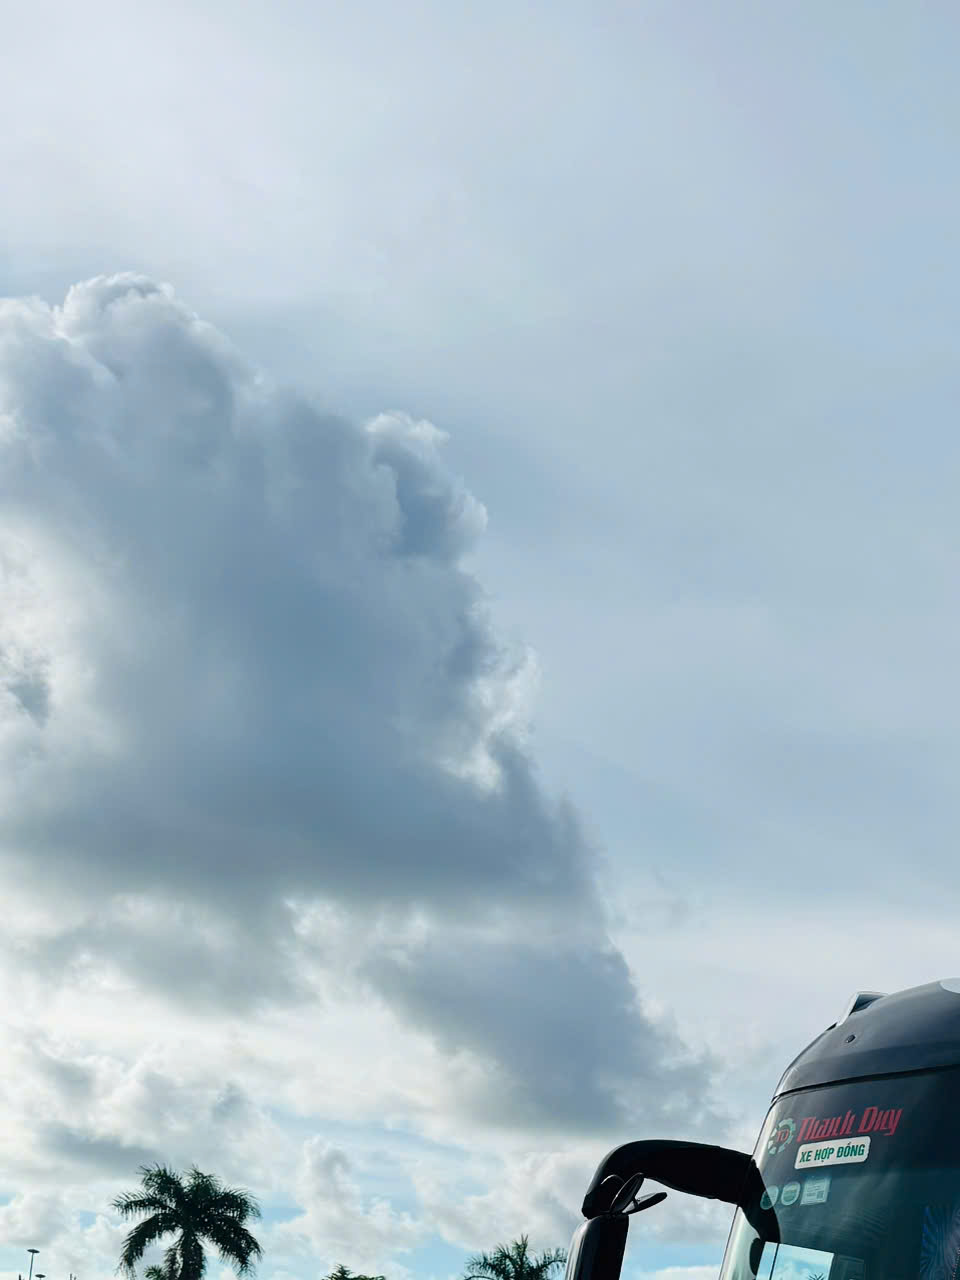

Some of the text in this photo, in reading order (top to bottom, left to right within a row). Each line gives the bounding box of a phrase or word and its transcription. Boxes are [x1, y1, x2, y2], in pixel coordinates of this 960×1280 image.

[796, 1106, 904, 1142] Thanh Duy
[799, 1142, 866, 1163] XE HỢP ĐỒNG
